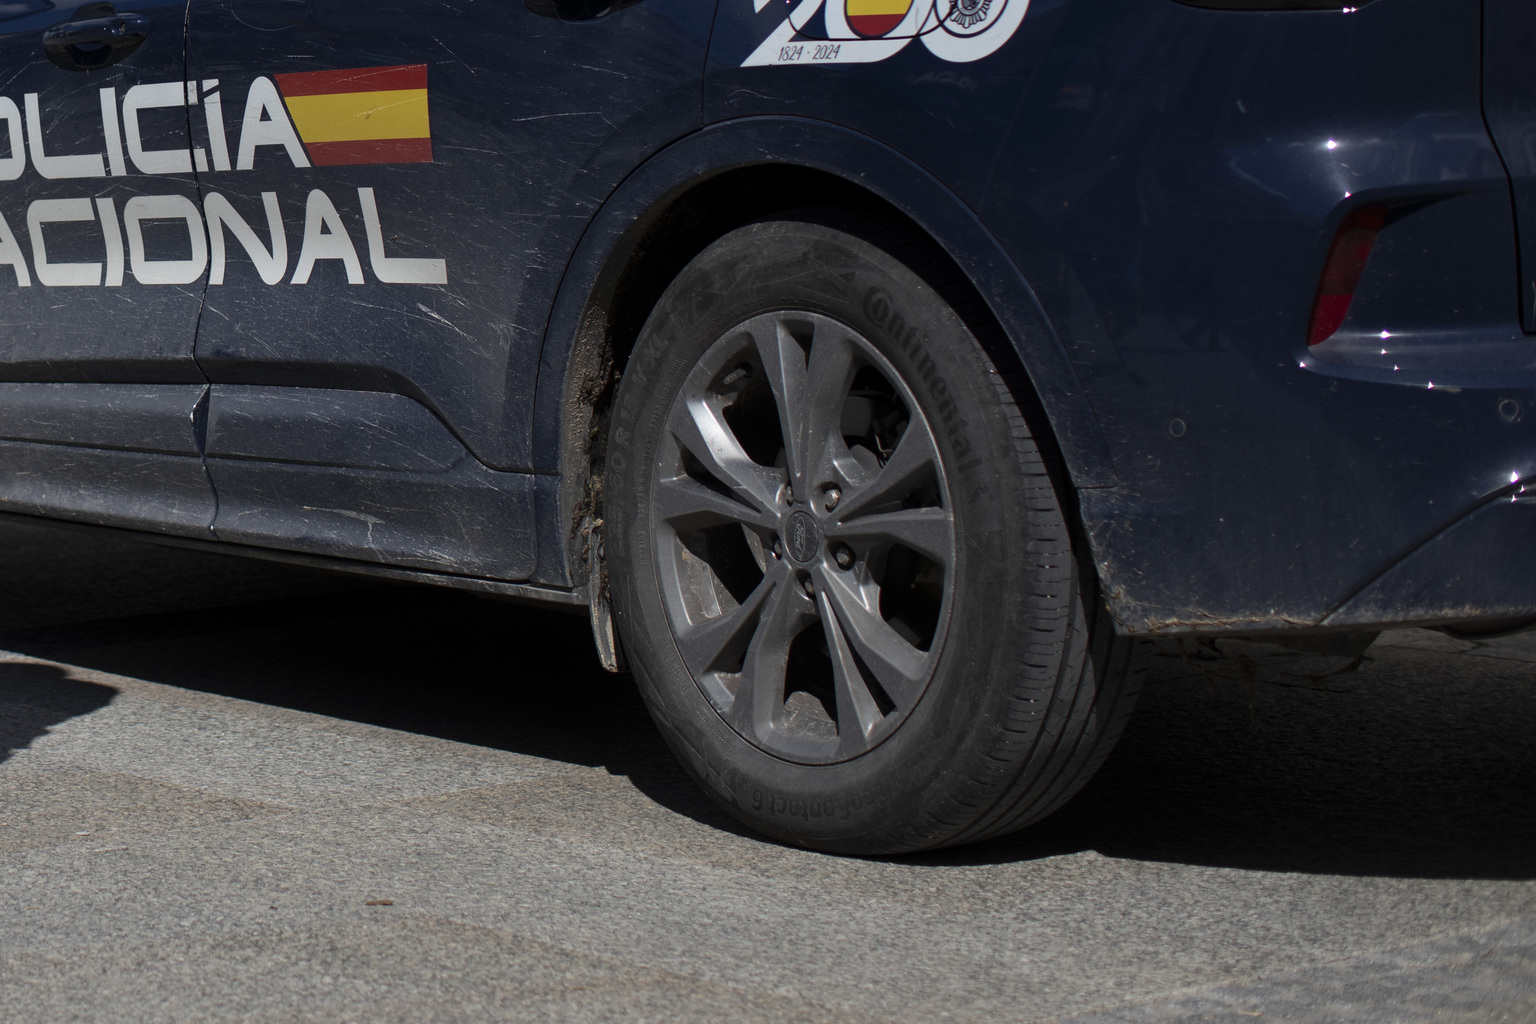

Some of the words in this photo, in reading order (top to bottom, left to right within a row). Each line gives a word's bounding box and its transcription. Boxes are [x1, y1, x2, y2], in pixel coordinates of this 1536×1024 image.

[777, 45, 803, 61] 1824
[812, 44, 841, 60] 2024
[862, 285, 984, 473] Continental
